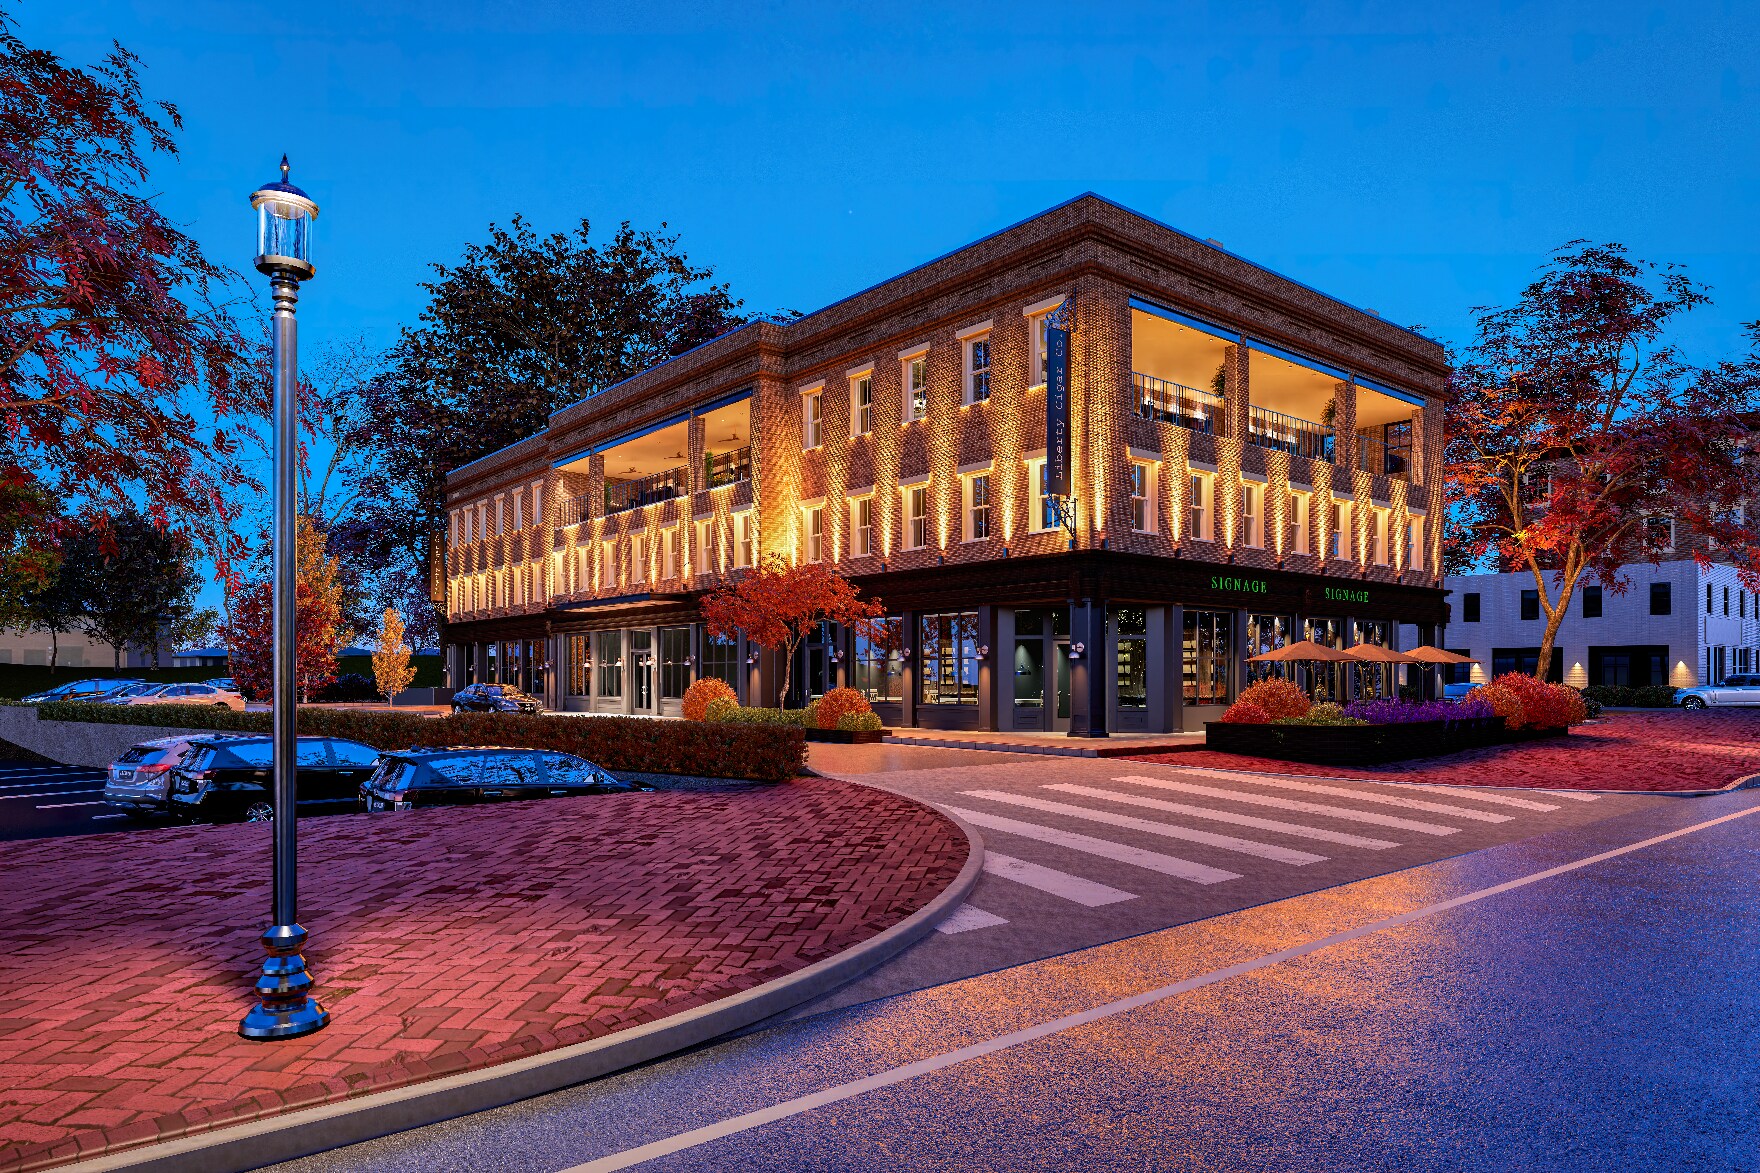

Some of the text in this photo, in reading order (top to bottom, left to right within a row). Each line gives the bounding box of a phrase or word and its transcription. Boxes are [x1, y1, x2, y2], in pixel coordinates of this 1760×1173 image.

[1055, 333, 1065, 481] Liberty Cigar Co.
[1211, 576, 1267, 594] SIGNAGE
[1325, 587, 1369, 603] SIGNAGE
